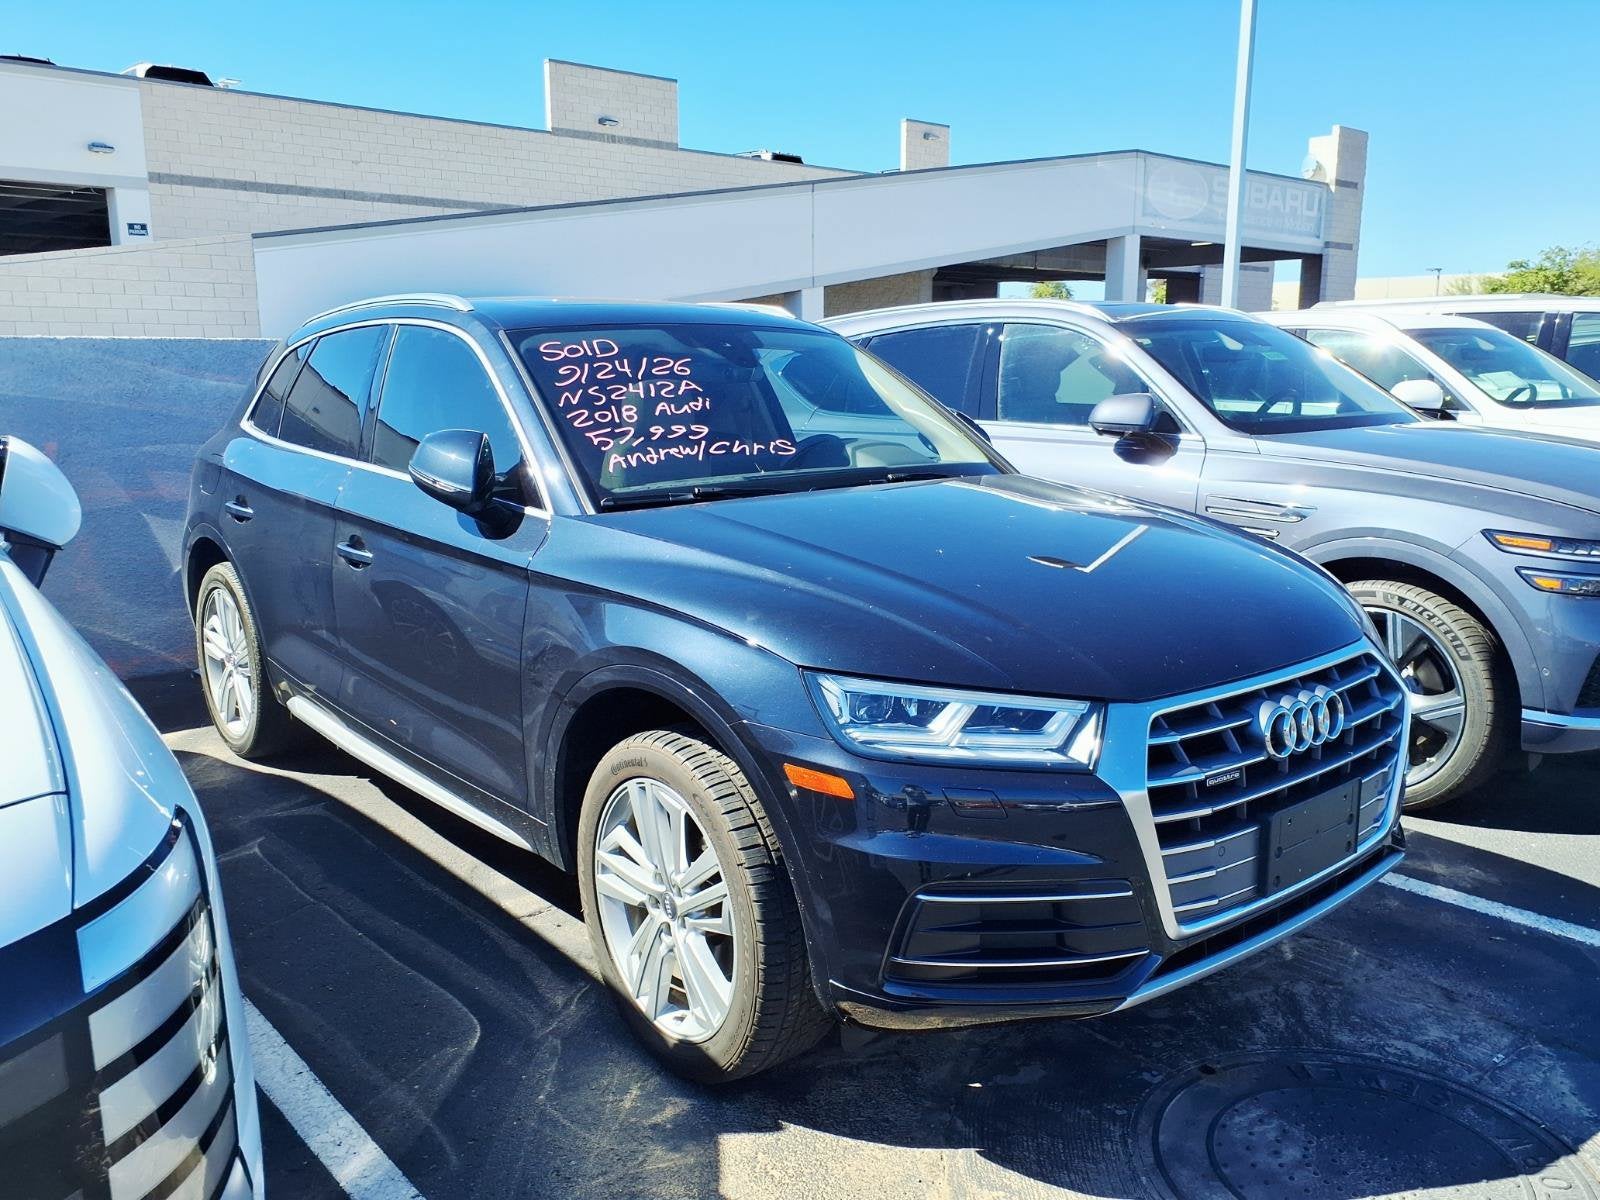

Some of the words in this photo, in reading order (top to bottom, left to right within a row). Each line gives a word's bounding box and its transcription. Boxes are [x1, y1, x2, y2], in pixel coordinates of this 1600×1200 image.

[555, 357, 692, 387] 9/24/26
[567, 405, 638, 428] 2018
[655, 397, 710, 416] Audi
[1402, 600, 1469, 657] MICHELIN
[610, 757, 643, 776] Continental
[1208, 772, 1240, 786] quattro
